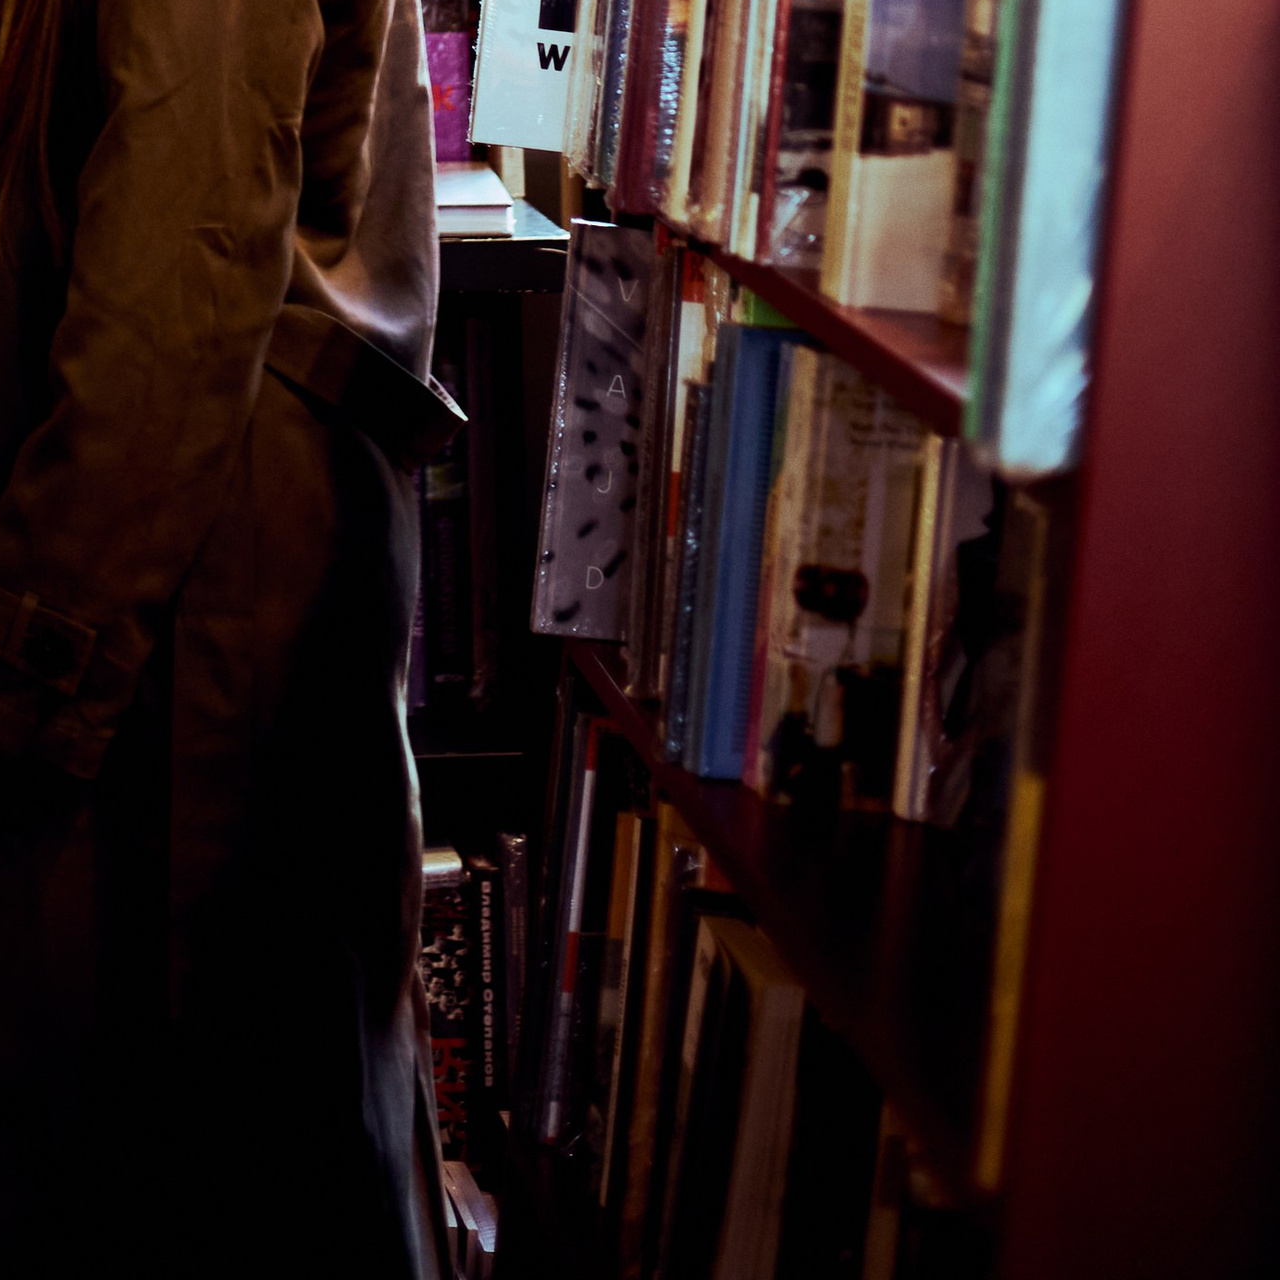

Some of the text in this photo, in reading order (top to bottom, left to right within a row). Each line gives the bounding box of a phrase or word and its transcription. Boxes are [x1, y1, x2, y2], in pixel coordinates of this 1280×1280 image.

[537, 42, 571, 72] W
[606, 375, 627, 399] A
[585, 566, 604, 590] D
[480, 880, 494, 984] Владимир
